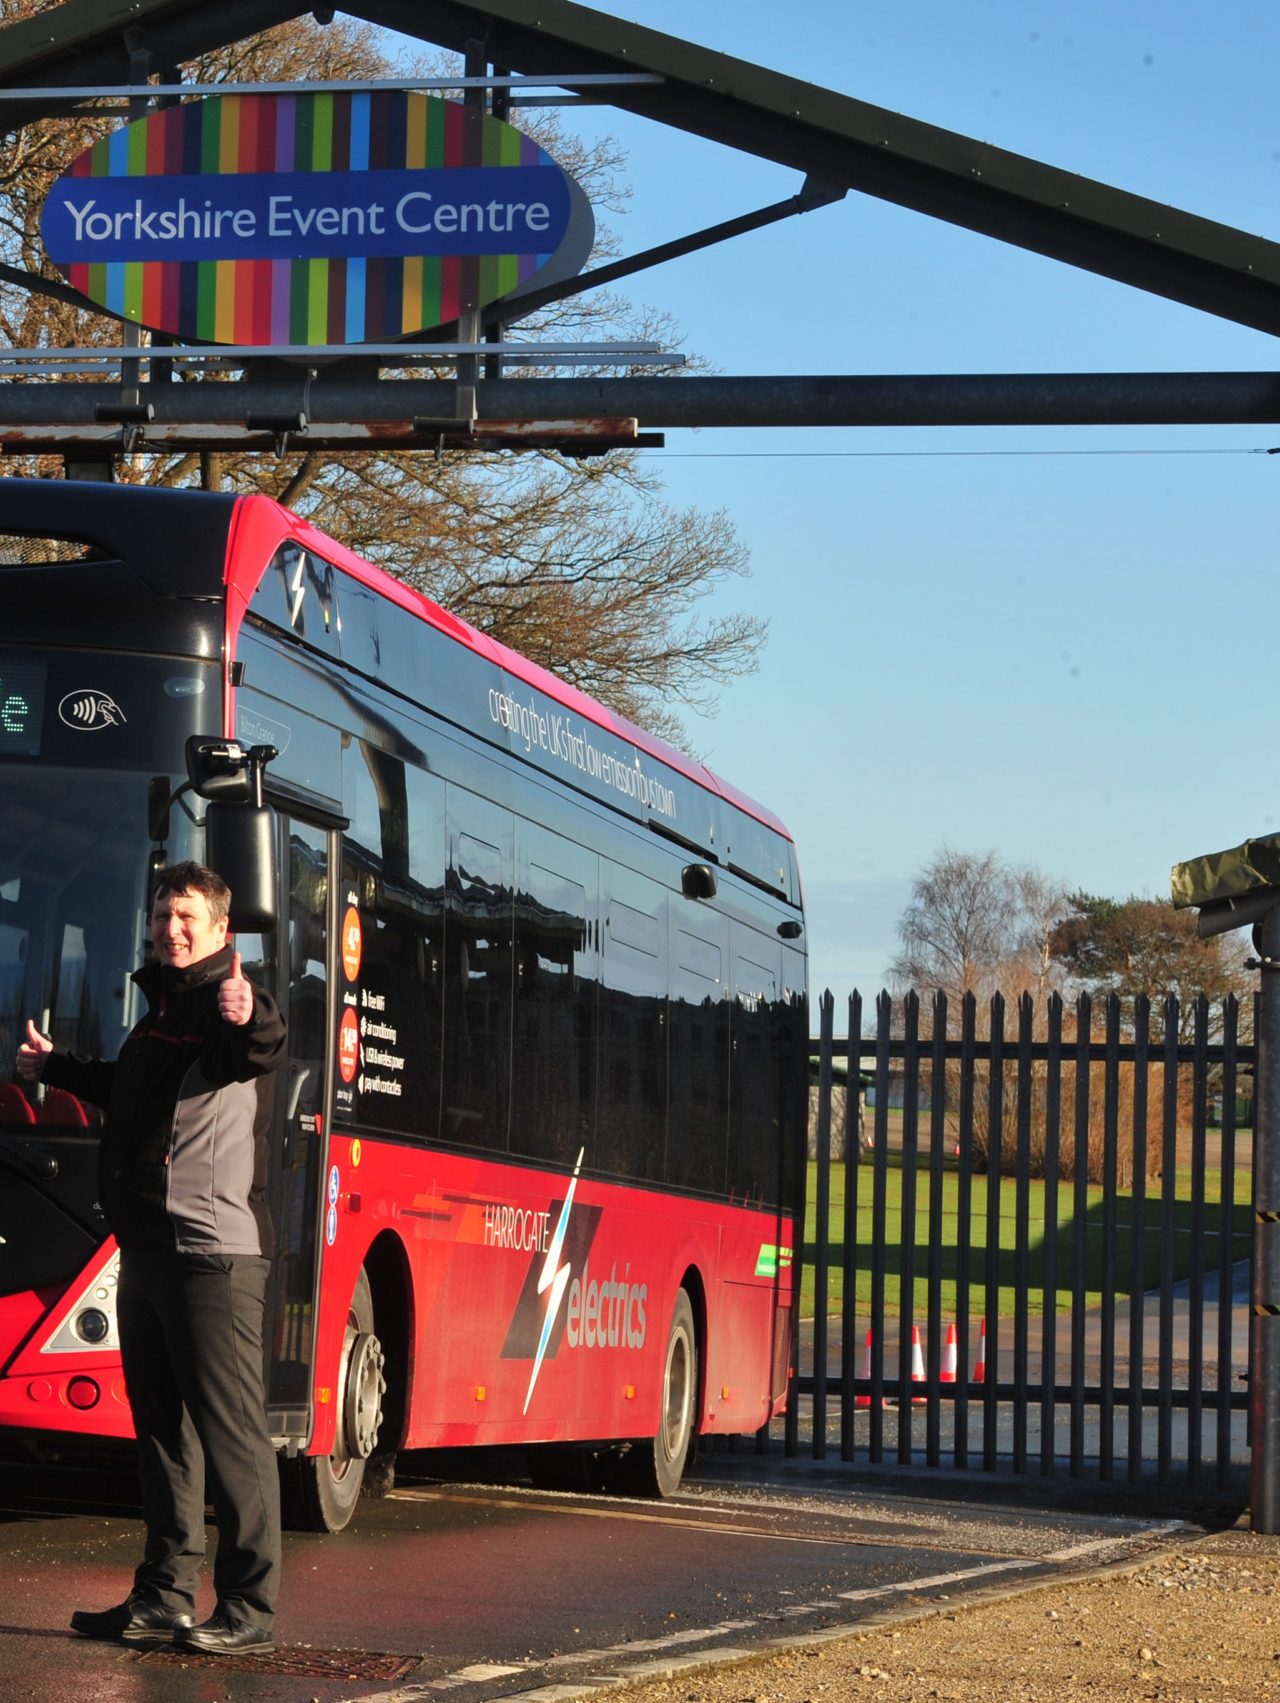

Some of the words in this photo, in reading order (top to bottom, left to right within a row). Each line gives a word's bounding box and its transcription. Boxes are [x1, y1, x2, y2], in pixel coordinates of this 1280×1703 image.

[63, 198, 257, 241] Yorkshire
[268, 195, 386, 238] Event
[396, 191, 551, 235] Centre
[488, 688, 531, 753] creating
[529, 696, 548, 750] the
[566, 718, 587, 771] first
[584, 728, 602, 780] low
[483, 1204, 551, 1253] HARROGATE
[567, 1258, 648, 1349] electrics
